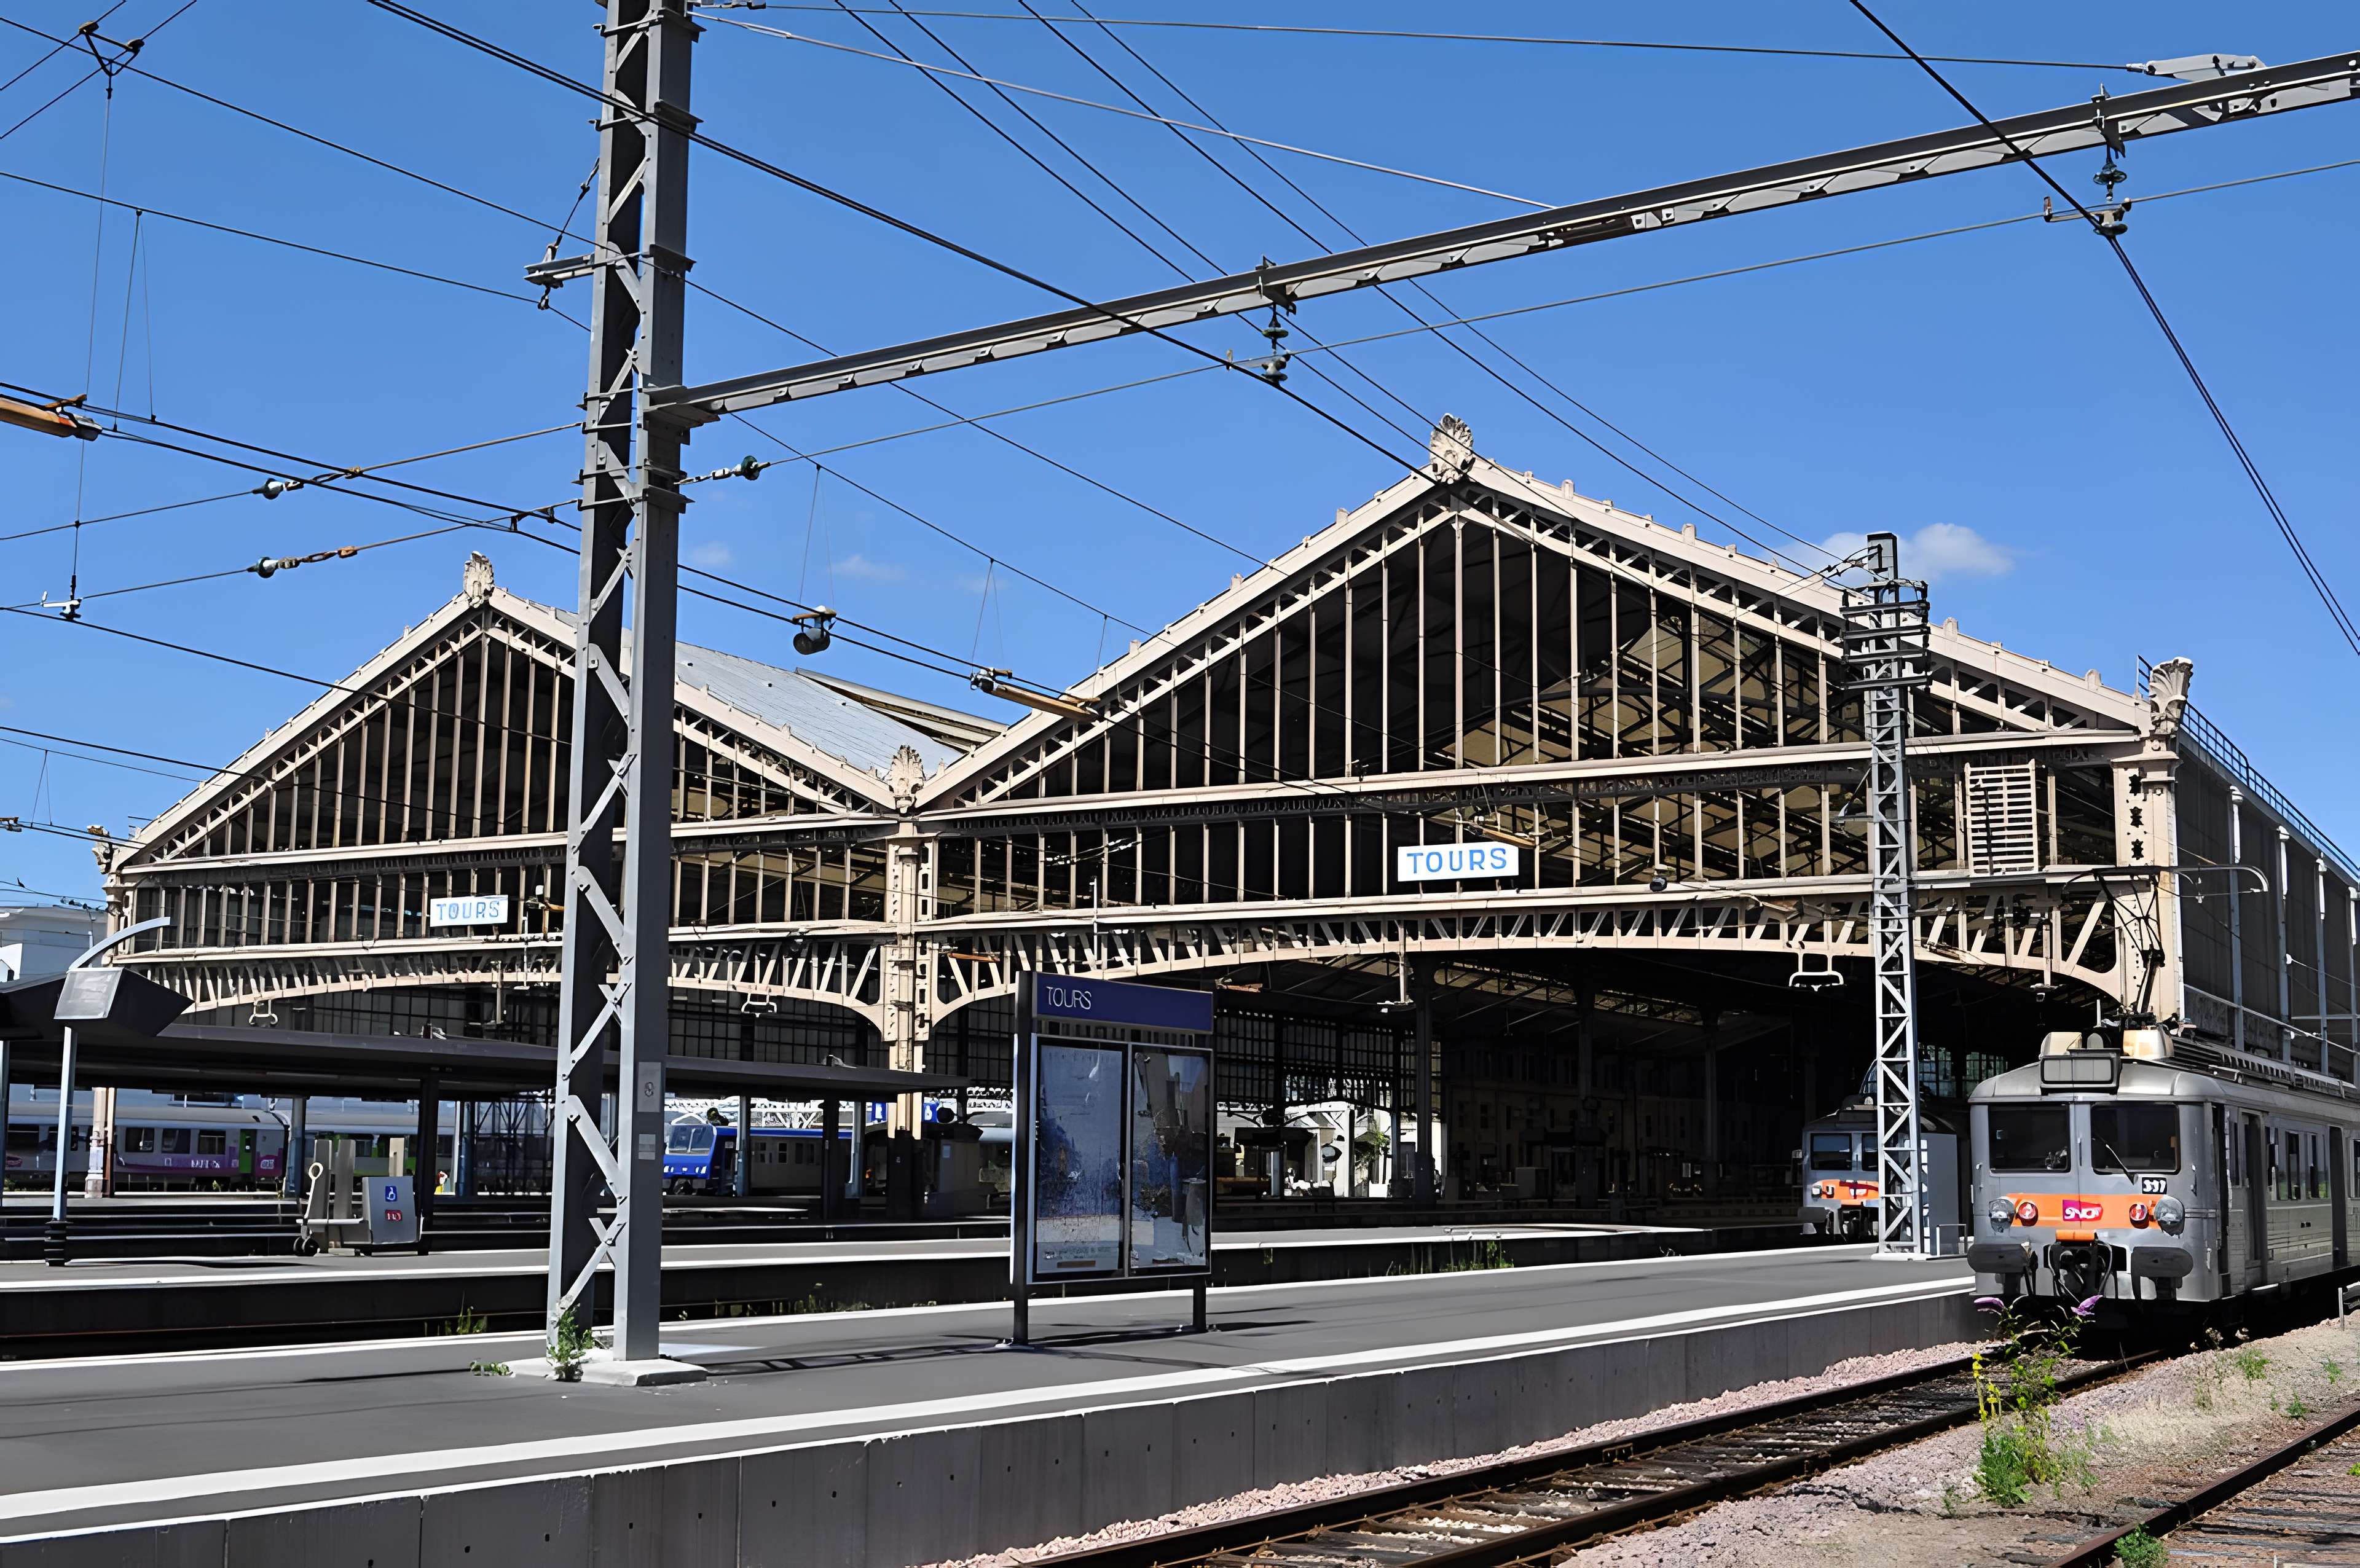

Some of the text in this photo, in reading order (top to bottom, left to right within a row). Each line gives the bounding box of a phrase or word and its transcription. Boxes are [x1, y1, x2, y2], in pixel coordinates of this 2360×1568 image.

[1407, 848, 1507, 874] TOURS
[436, 900, 500, 920] TOURS
[1046, 986, 1092, 1009] TOURS
